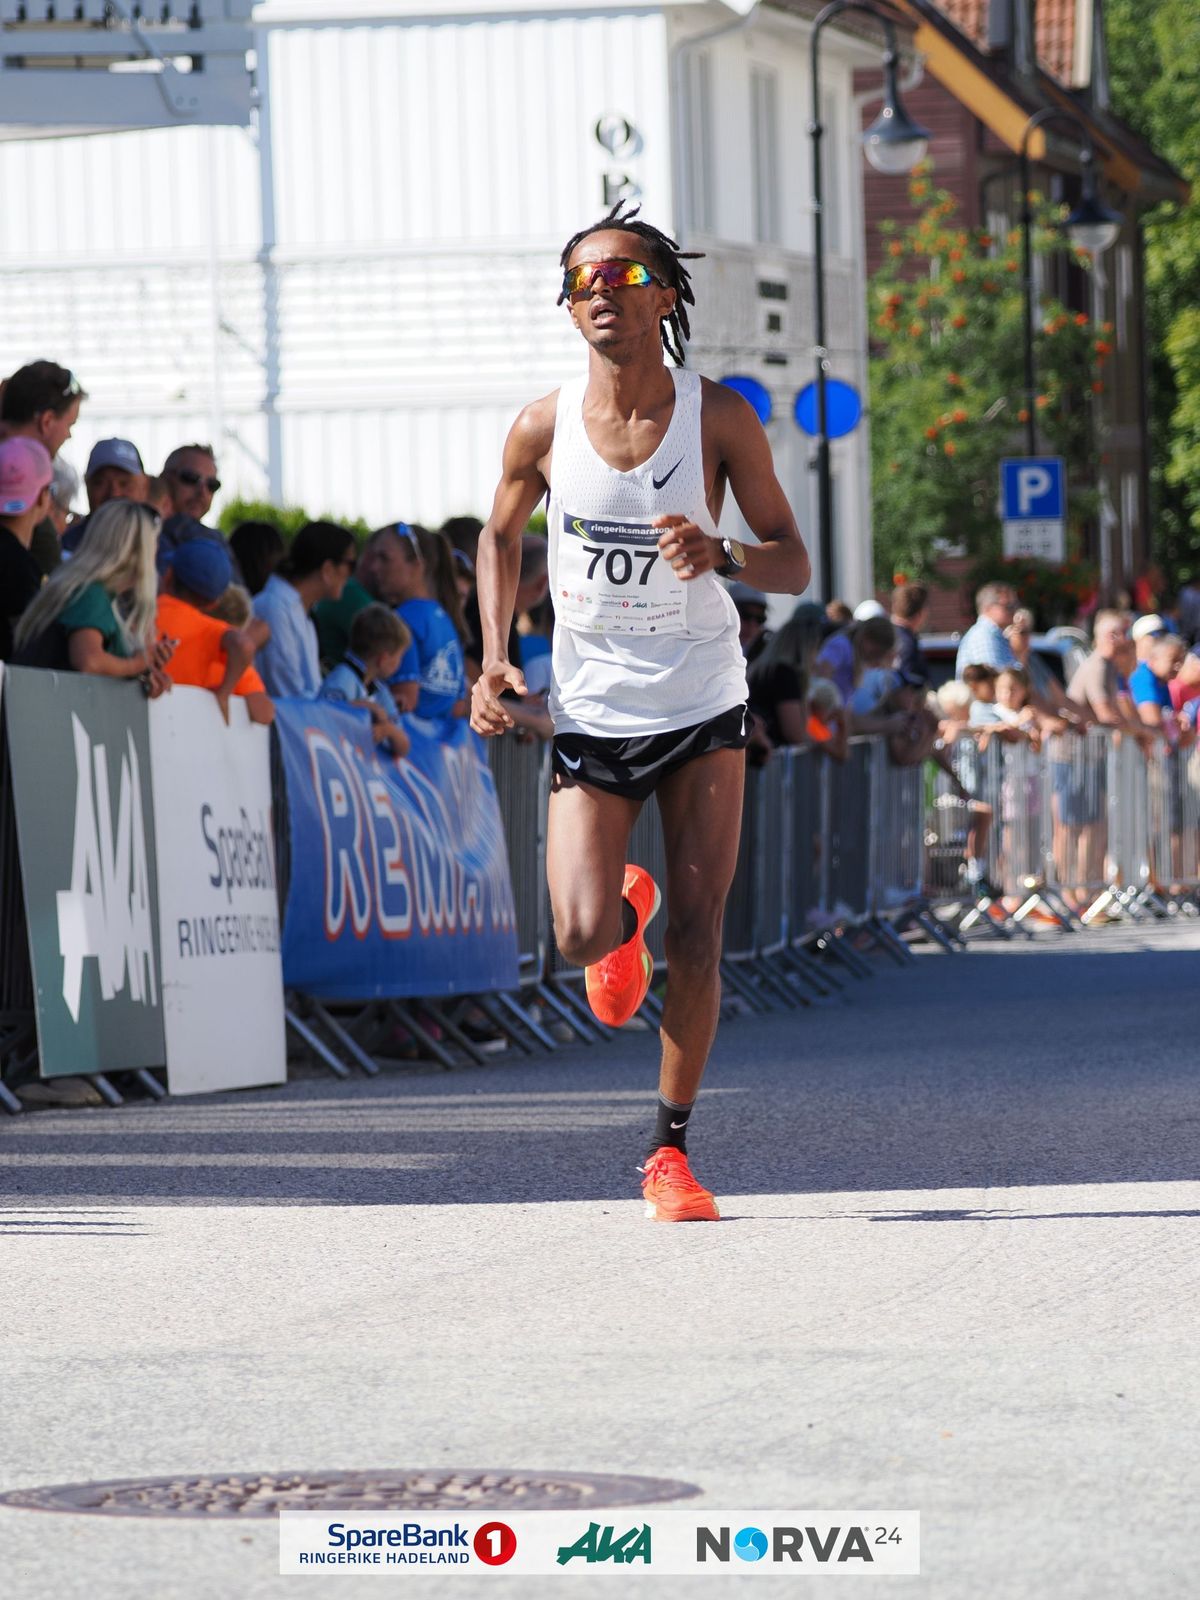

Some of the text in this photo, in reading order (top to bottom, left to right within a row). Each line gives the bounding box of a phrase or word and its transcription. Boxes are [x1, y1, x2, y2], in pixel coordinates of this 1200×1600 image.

[1018, 466, 1051, 513] P
[582, 545, 660, 586] 707
[56, 711, 157, 1024] AKA
